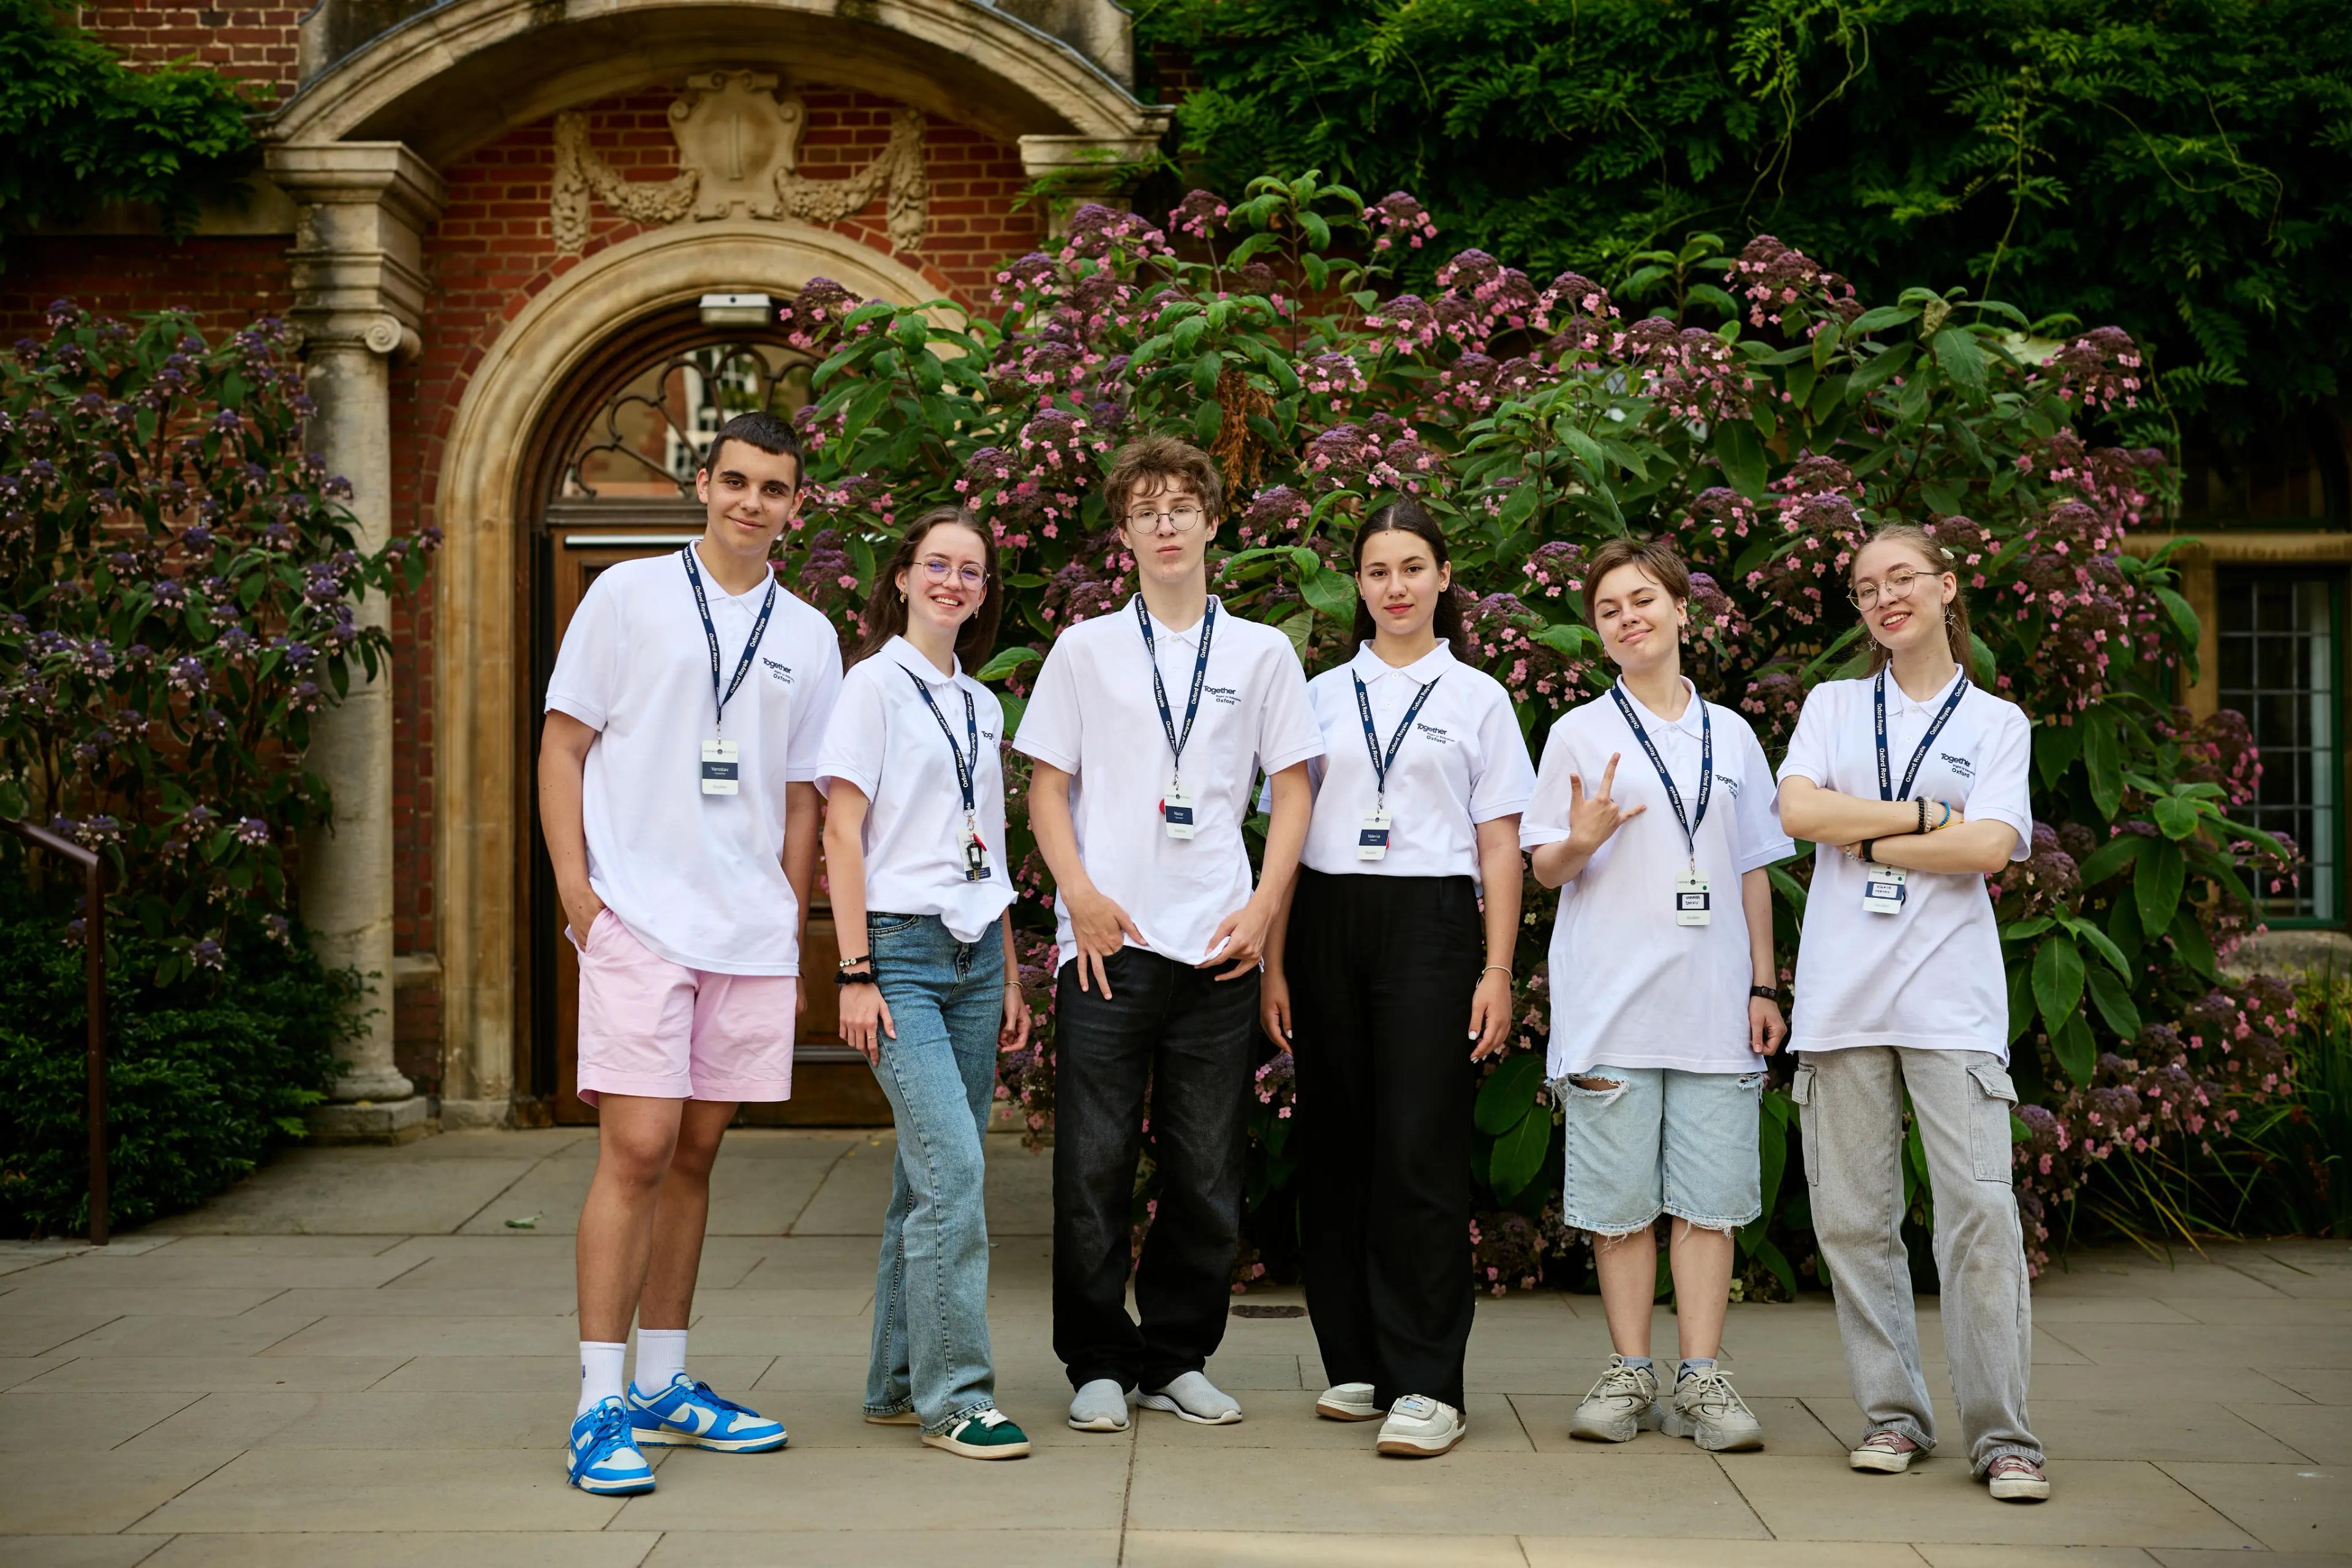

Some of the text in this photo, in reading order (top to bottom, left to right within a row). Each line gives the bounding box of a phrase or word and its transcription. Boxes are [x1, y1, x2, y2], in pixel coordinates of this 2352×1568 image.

[686, 559, 695, 574] Royale
[695, 586, 703, 601] Oxford
[750, 617, 766, 647] Oxford Royale
[763, 657, 791, 674] Together
[730, 659, 748, 693] Oxford Royale
[773, 674, 790, 684] Oxford
[1156, 689, 1165, 708] Royale
[1191, 686, 1199, 704] Oxford
[1204, 685, 1236, 695] Together
[1954, 682, 1965, 697] Oxford
[1412, 696, 1423, 710] Oxford
[931, 702, 951, 735] Oxford Royale
[1619, 698, 1639, 729] Oxford Royale
[1930, 706, 1951, 735] Oxford Royale
[1178, 718, 1192, 755] Oxford Royale
[1389, 722, 1409, 755] Oxford Royale
[1417, 723, 1447, 735] Together
[1427, 735, 1446, 744] Oxford
[1644, 740, 1665, 774] Oxford Royale
[1905, 745, 1926, 783] Oxford Royale
[1941, 753, 1971, 767] Together
[960, 769, 968, 788] Oxford
[1951, 768, 1970, 778] Oxford
[1669, 786, 1686, 824] Oxford Royale
[1700, 786, 1709, 805] Royale
